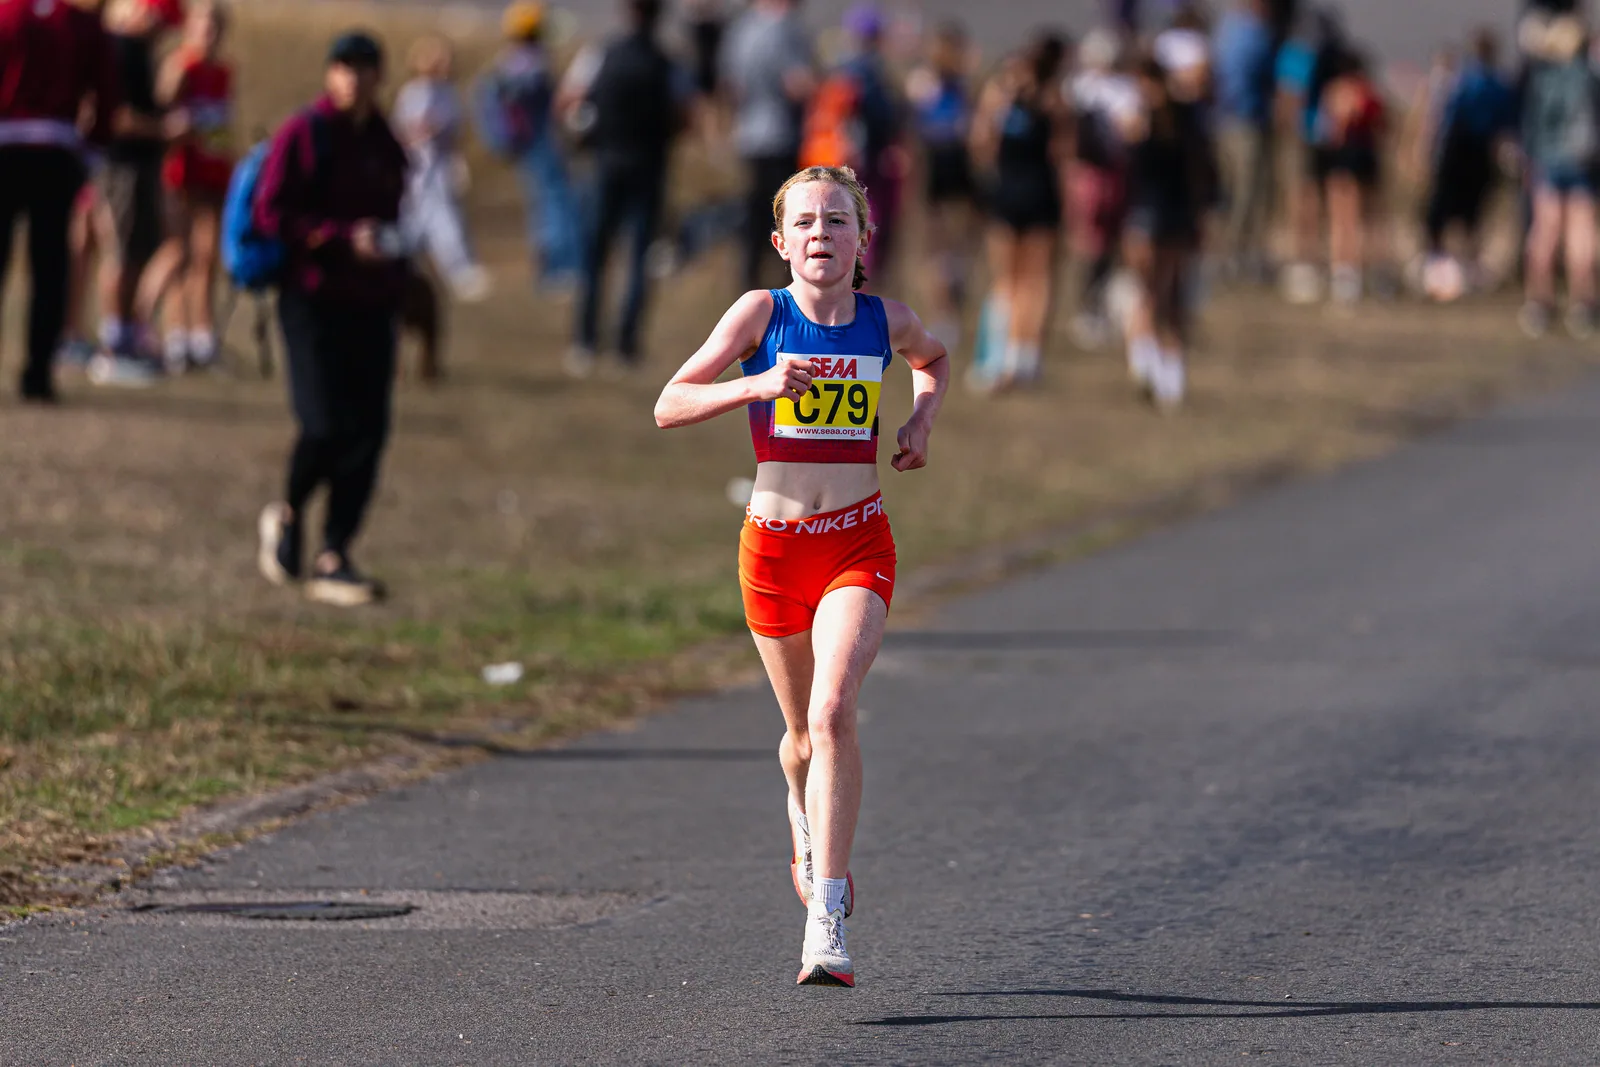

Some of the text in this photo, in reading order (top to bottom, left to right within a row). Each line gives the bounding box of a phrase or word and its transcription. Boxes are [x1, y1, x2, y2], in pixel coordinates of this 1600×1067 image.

[808, 357, 857, 379] SEAA
[794, 384, 868, 425] C79
[796, 428, 867, 436] www.seaa.org.uk
[795, 509, 859, 534] NIKE
